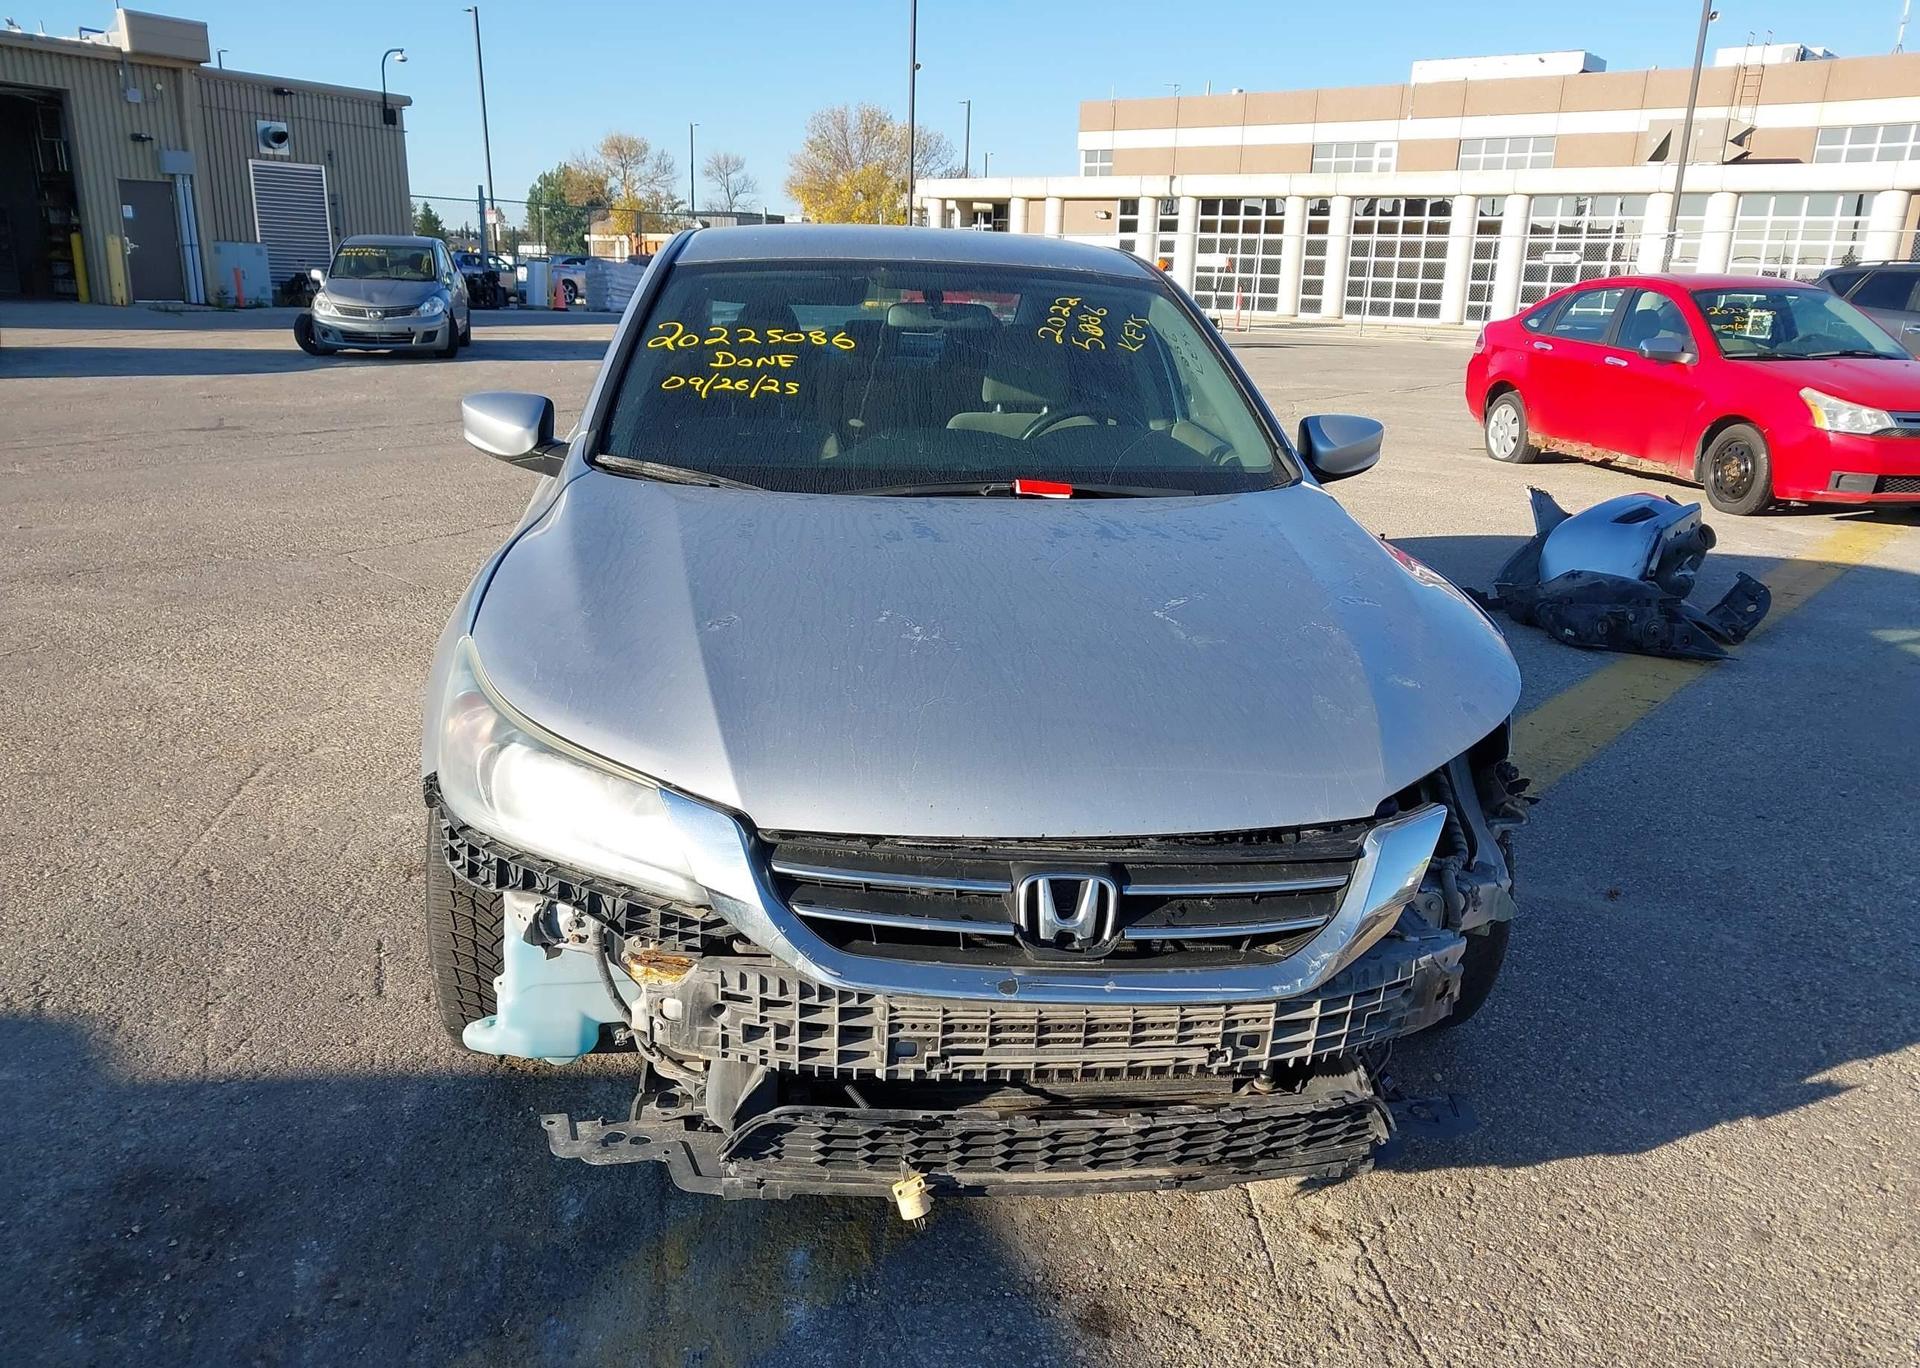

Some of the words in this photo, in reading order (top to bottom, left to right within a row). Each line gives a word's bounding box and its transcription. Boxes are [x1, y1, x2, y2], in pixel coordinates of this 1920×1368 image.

[1037, 296, 1082, 345] 2022
[1117, 313, 1149, 352] KEYS
[647, 321, 856, 350] 20225086
[709, 351, 799, 368] DONE
[661, 373, 800, 399] 09/26/25
